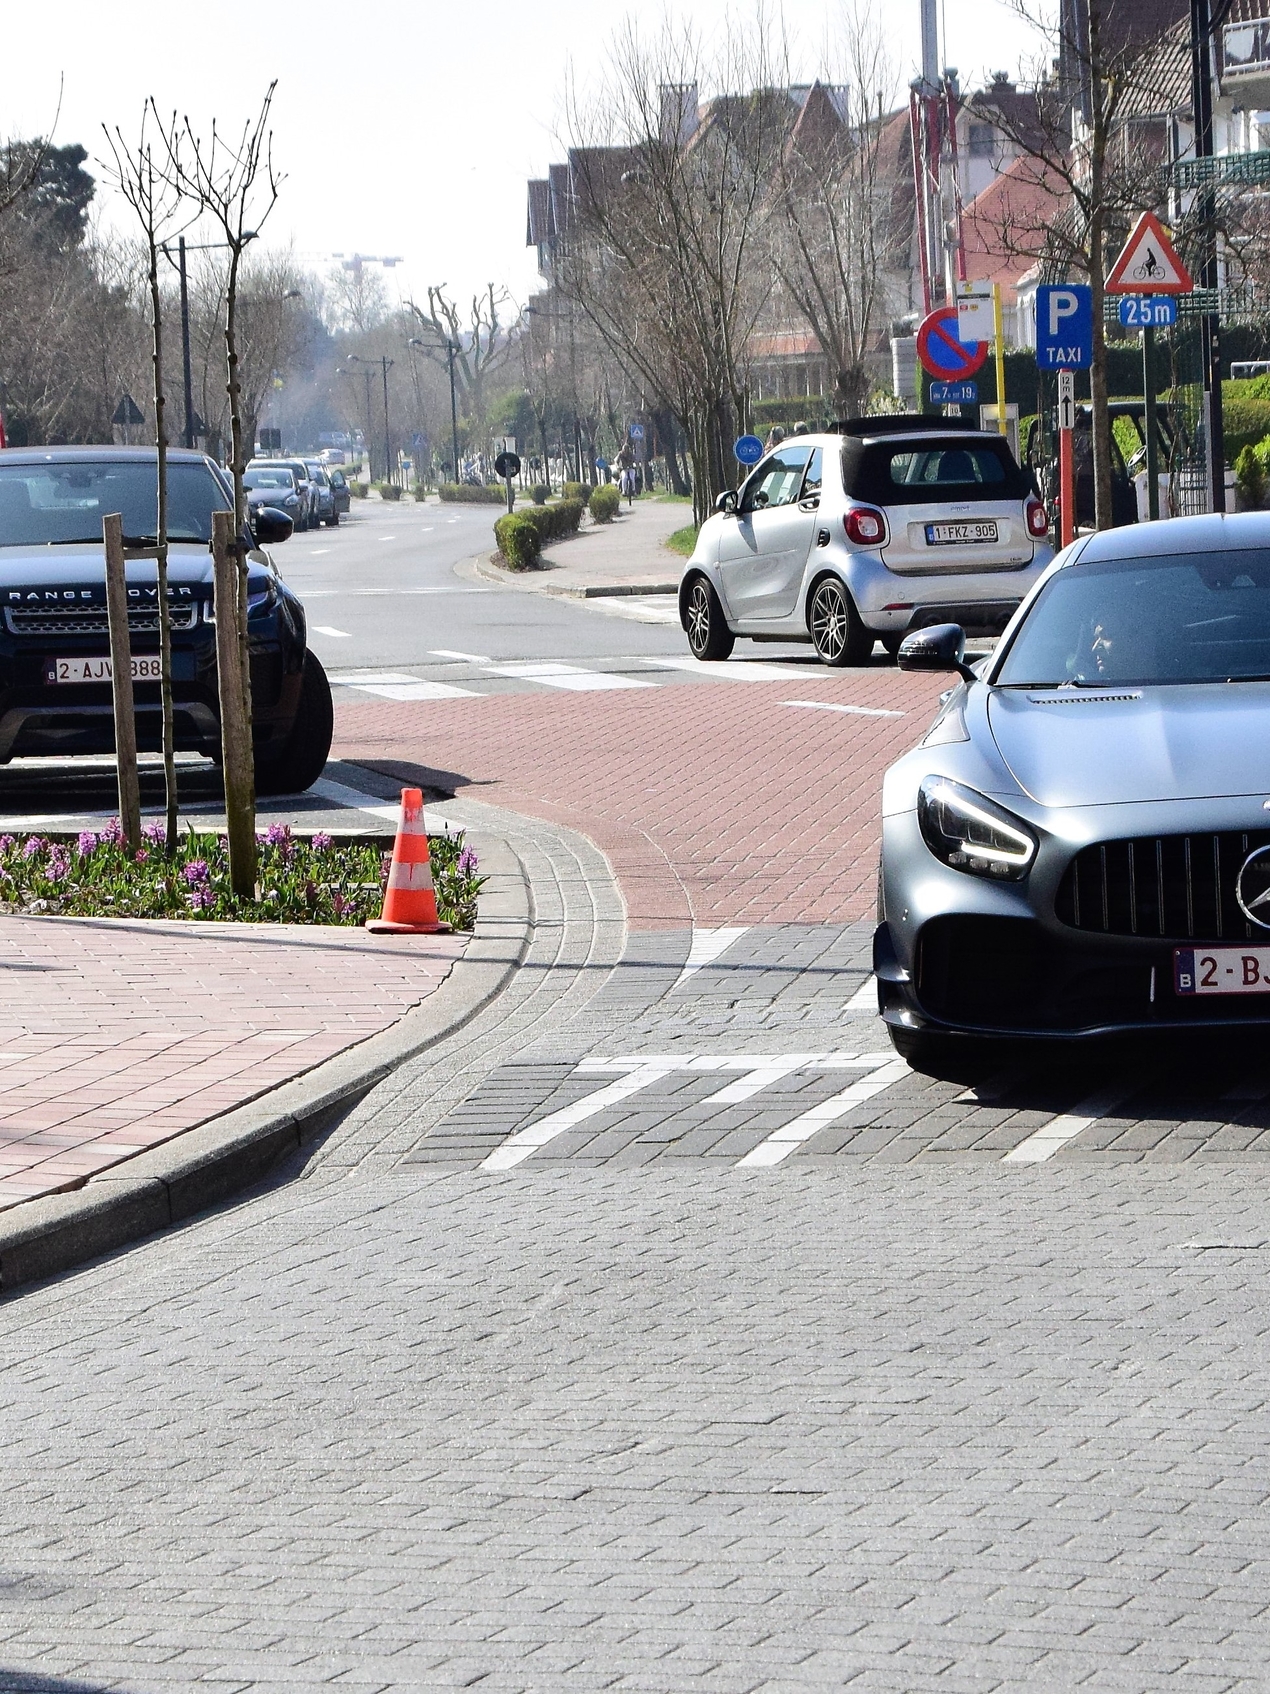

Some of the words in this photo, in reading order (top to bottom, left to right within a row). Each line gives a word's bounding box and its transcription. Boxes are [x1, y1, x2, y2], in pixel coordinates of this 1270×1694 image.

[1049, 291, 1079, 335] P
[1126, 299, 1170, 323] 25m
[1046, 347, 1082, 363] TAXI
[1061, 376, 1070, 385] 12
[9, 590, 93, 600] RANGE
[128, 587, 192, 598] OVER
[1180, 974, 1191, 987] B
